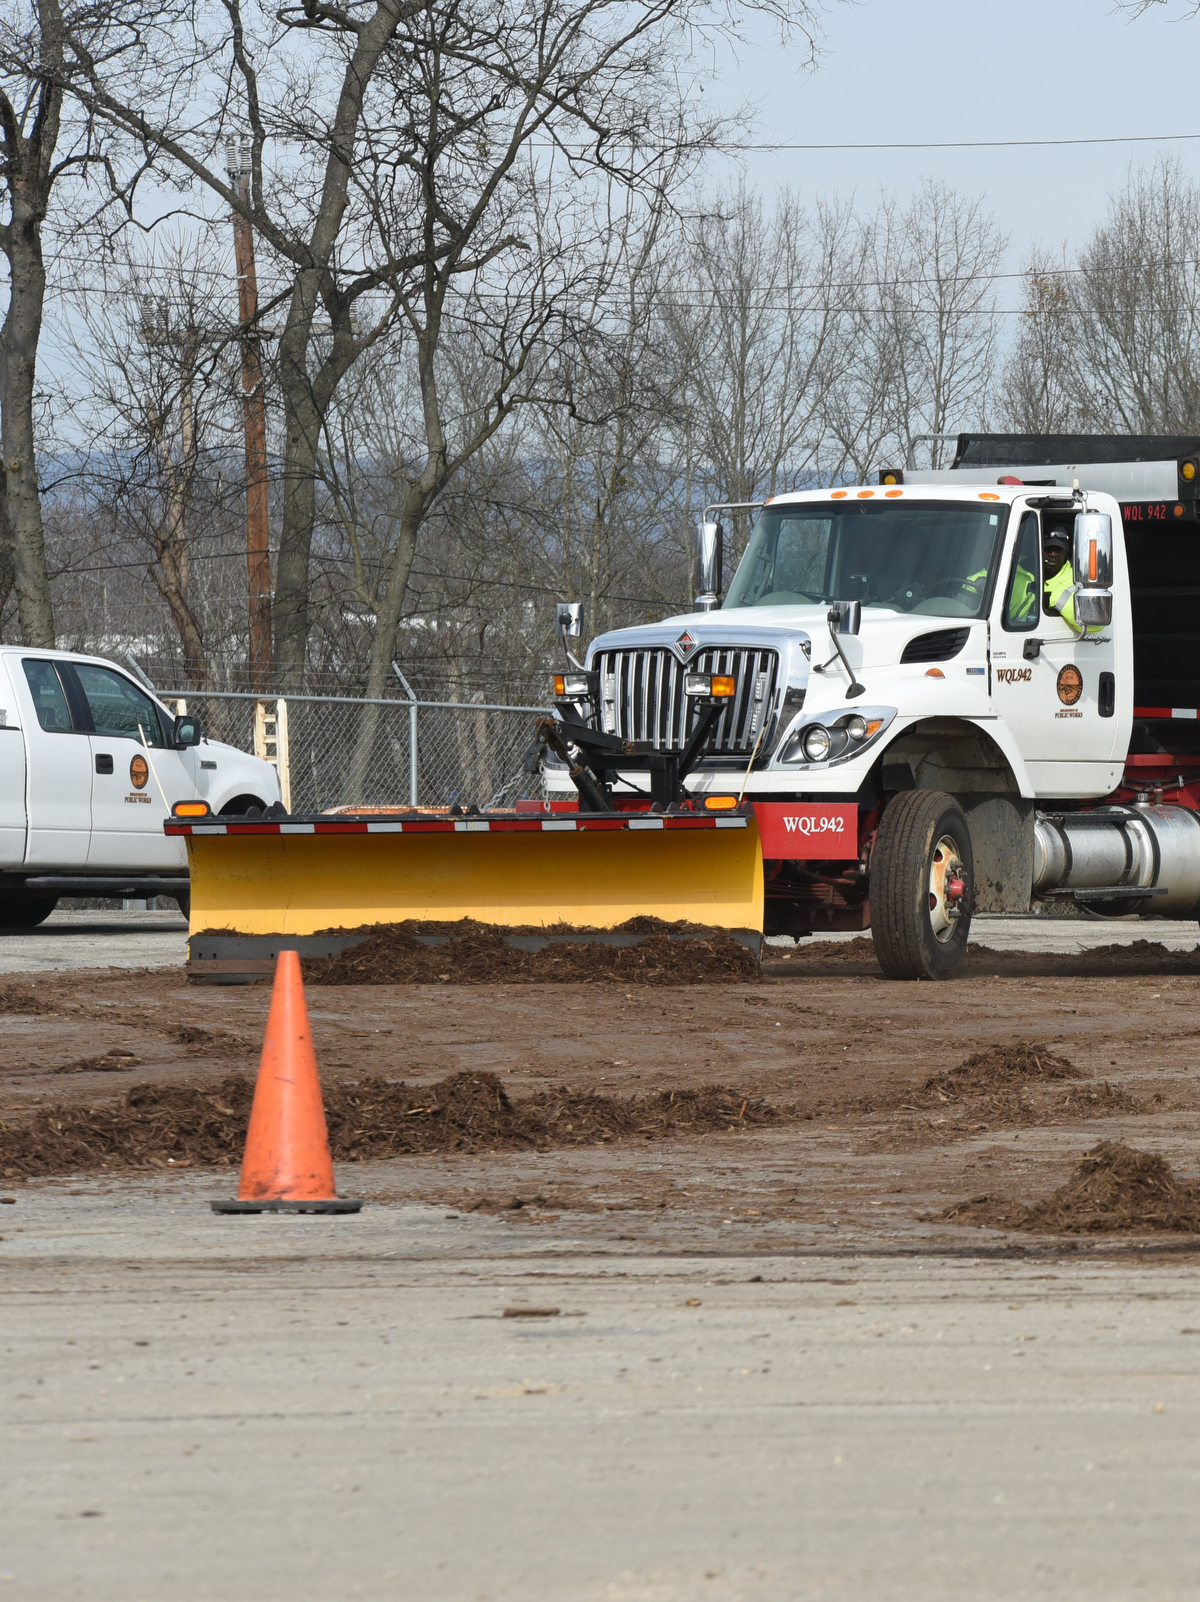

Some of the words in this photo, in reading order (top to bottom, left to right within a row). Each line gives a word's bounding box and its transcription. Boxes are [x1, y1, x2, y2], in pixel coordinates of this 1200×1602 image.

[1123, 505, 1143, 520] WQL
[1147, 504, 1166, 519] 942
[996, 668, 1032, 684] WQL942
[783, 817, 844, 836] WQL942
